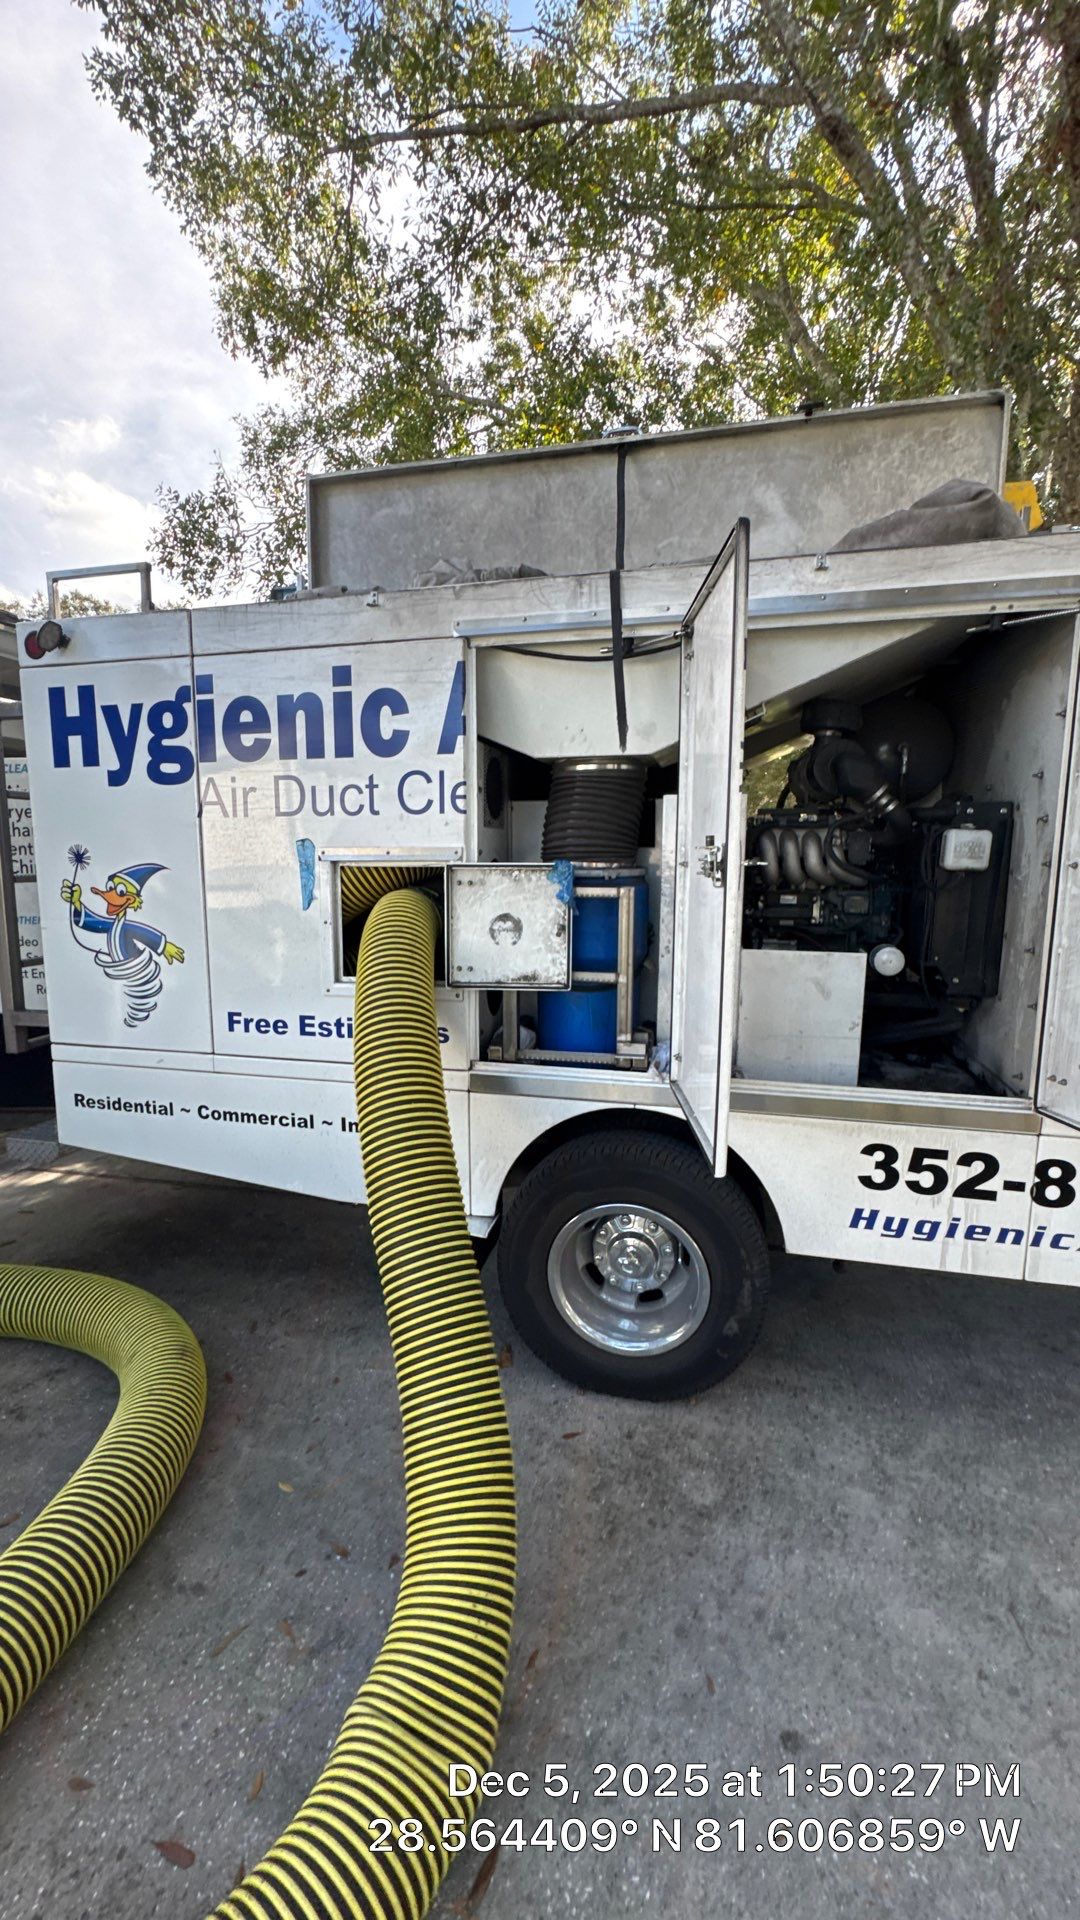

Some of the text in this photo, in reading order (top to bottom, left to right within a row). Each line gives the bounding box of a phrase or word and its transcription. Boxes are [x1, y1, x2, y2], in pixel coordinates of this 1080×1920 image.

[48, 664, 411, 787] Hygienic
[197, 775, 258, 819] Air
[273, 773, 381, 818] Duct
[227, 1011, 450, 1044] Free Estis
[73, 1092, 174, 1117] Residential
[197, 1104, 315, 1130] Commercial
[857, 1142, 1077, 1209] 352-8
[848, 1207, 1080, 1252] Hygienic
